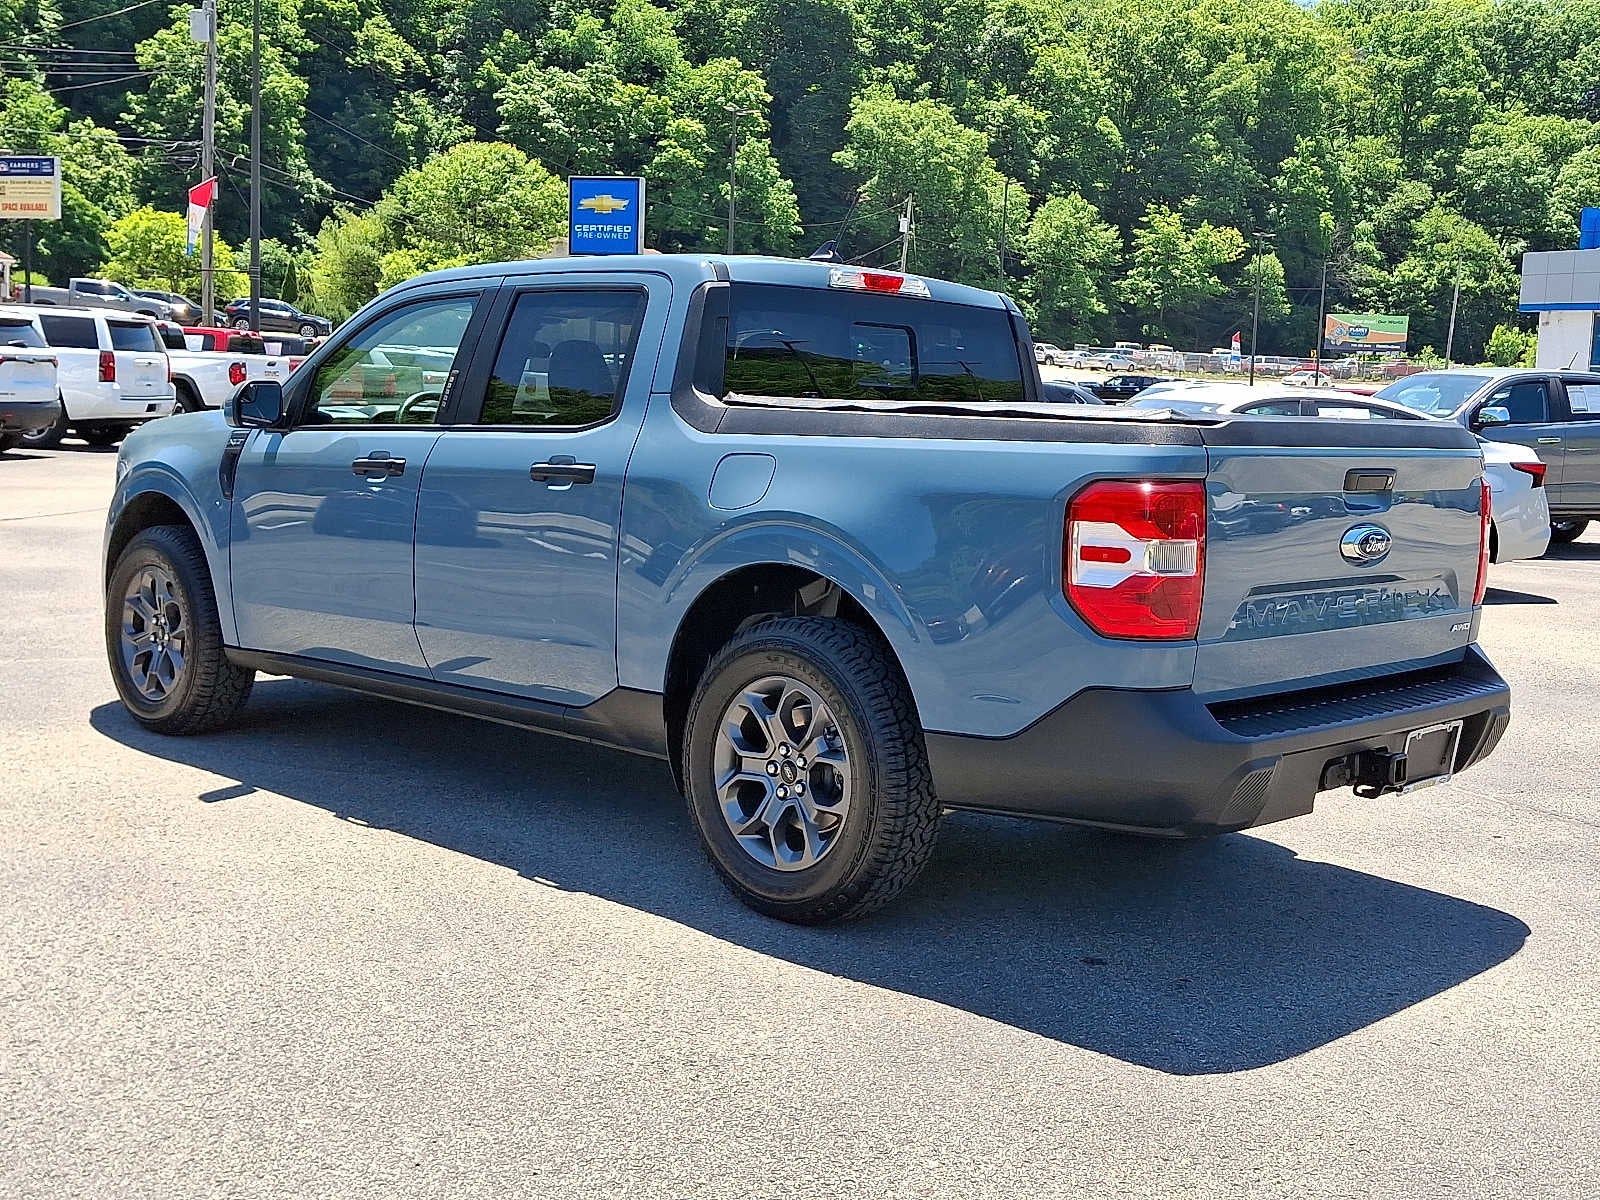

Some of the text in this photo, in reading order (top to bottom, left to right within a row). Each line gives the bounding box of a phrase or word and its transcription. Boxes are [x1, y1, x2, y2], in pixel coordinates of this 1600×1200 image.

[574, 224, 632, 233] CERTIFIED
[577, 231, 629, 240] PRE-OWNED
[1366, 534, 1387, 553] Ford
[1246, 587, 1441, 628] MAVERICK
